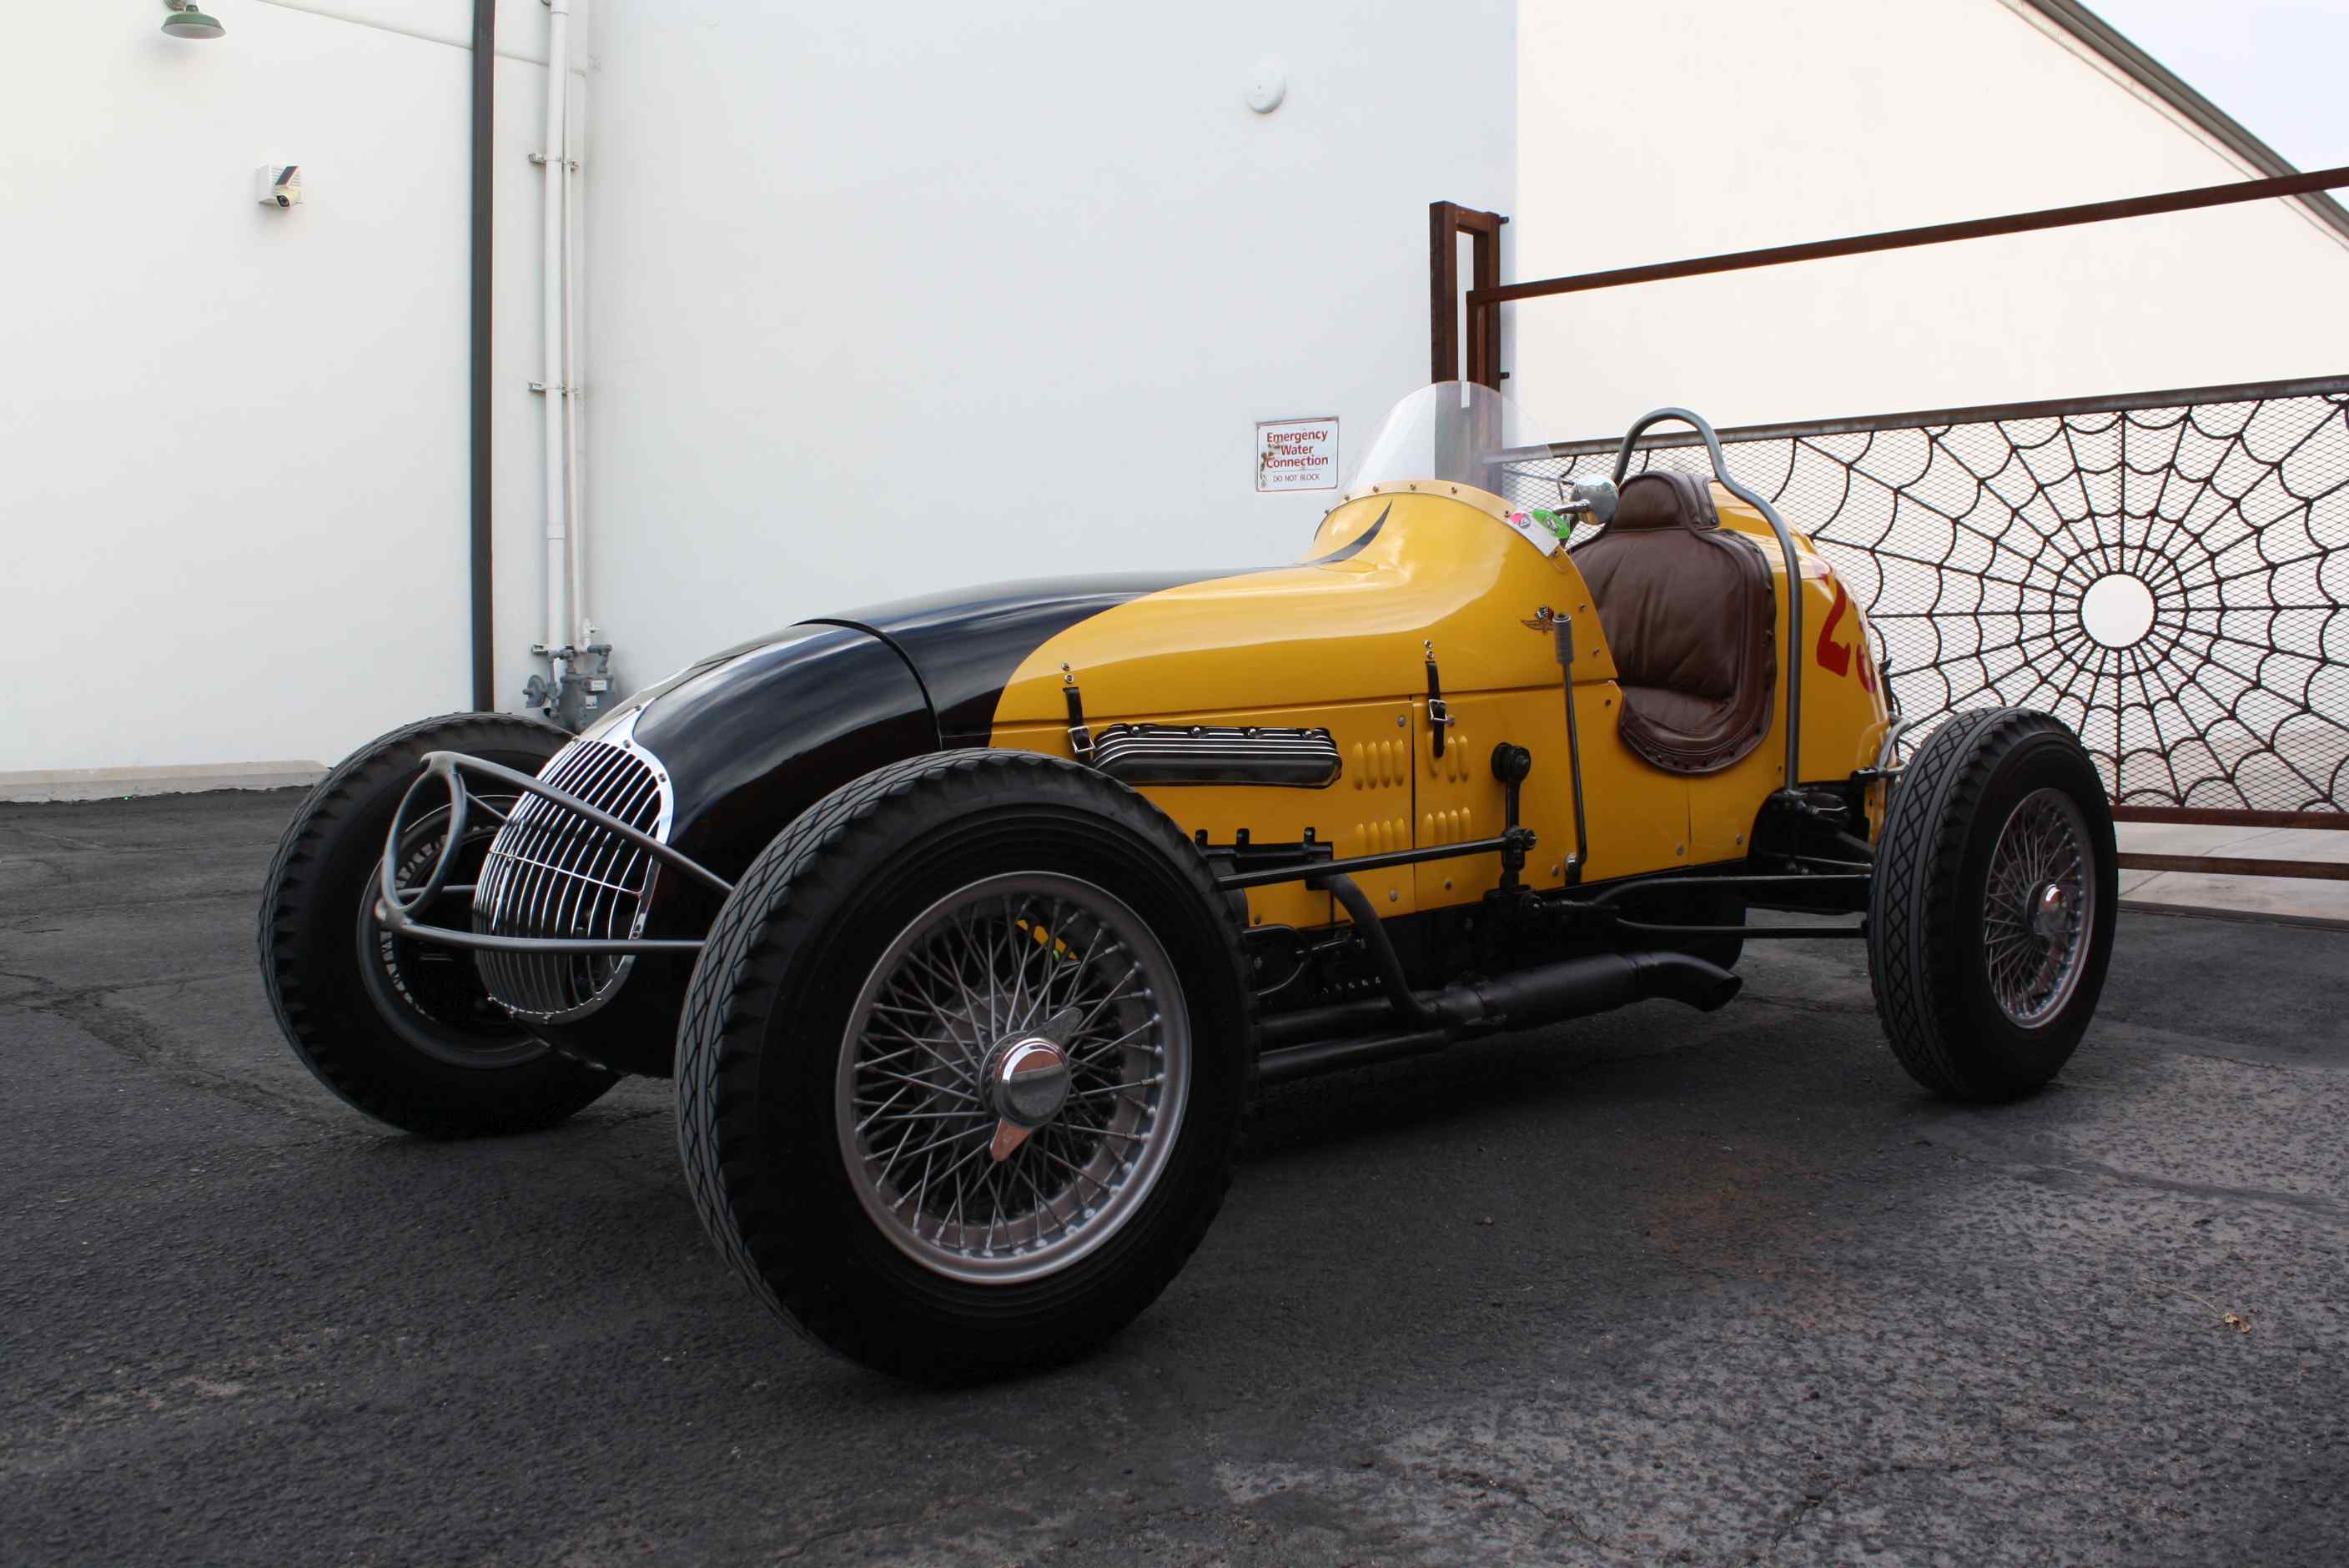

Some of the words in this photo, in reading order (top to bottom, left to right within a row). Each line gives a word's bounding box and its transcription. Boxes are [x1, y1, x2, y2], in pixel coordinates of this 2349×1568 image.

[1267, 430, 1328, 443] Emergency
[1280, 445, 1313, 455] Water
[1266, 455, 1328, 468] Connection
